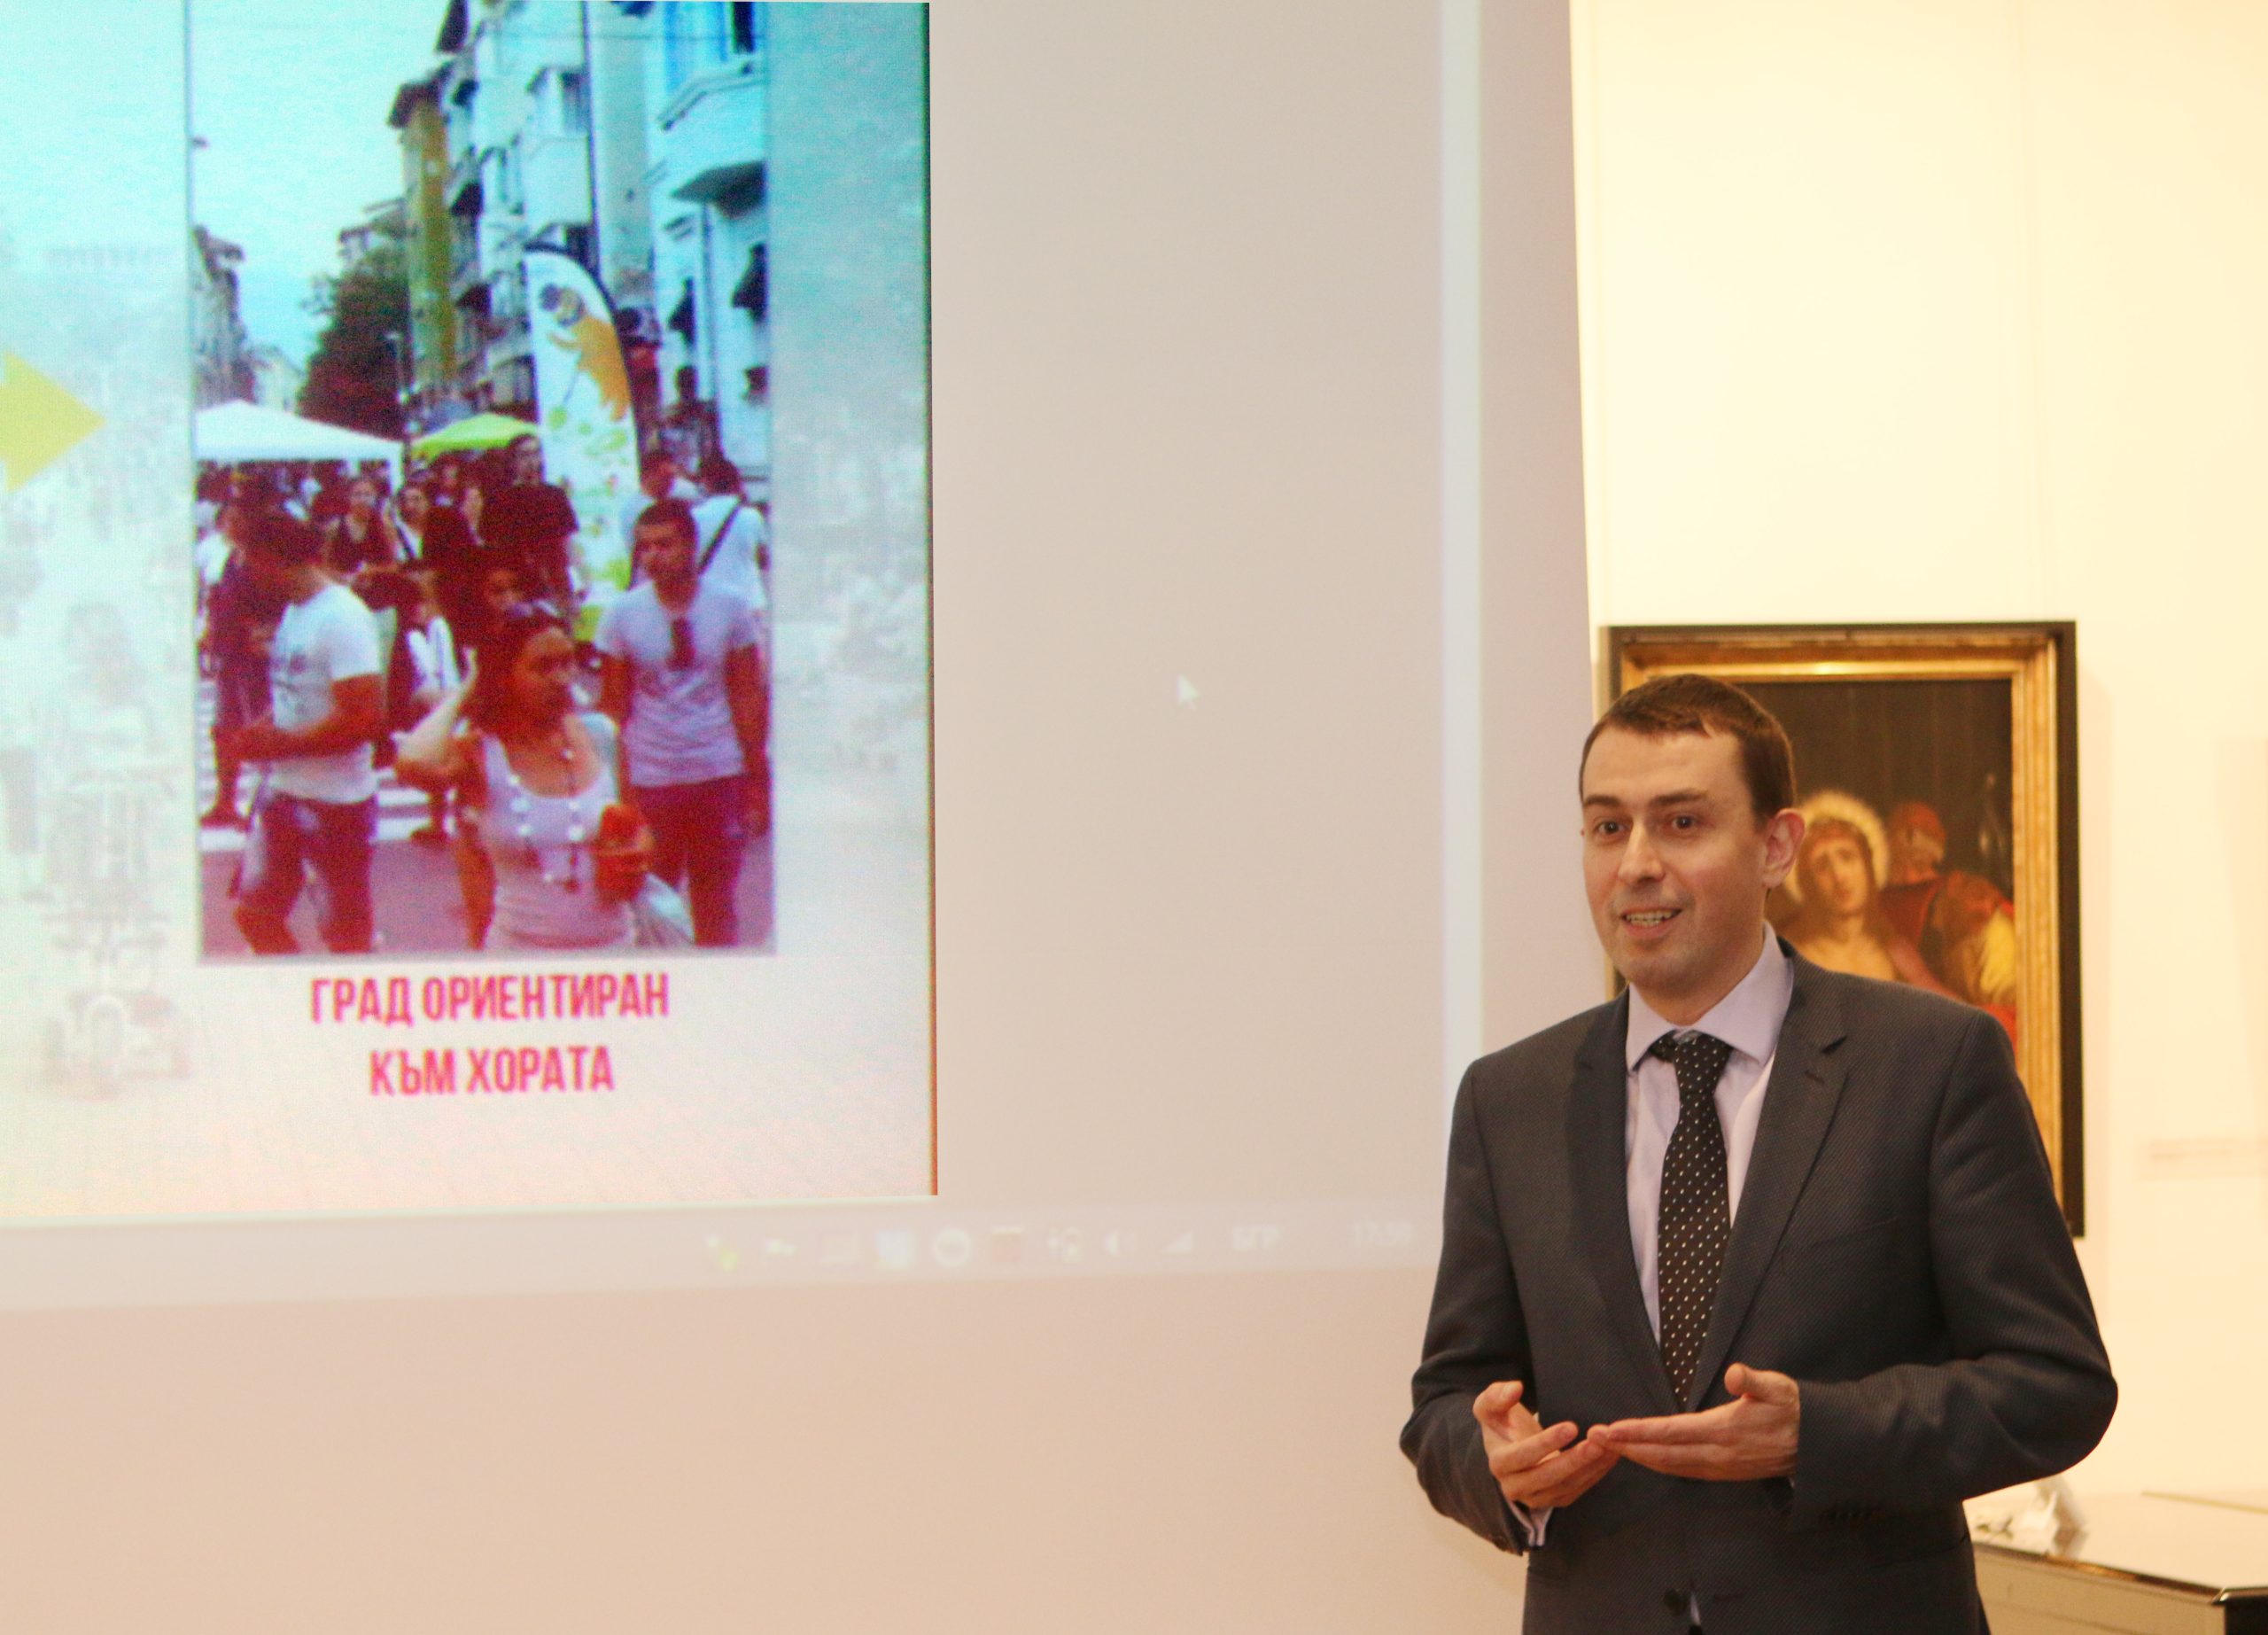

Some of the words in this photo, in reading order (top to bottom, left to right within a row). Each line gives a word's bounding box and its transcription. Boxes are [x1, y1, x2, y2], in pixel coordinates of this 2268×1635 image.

[310, 977, 415, 1028] ГРАД
[422, 972, 671, 1021] ОРИЕНТИРАН
[369, 1048, 459, 1097] КЪМ
[466, 1045, 616, 1094] ХОРАТА
